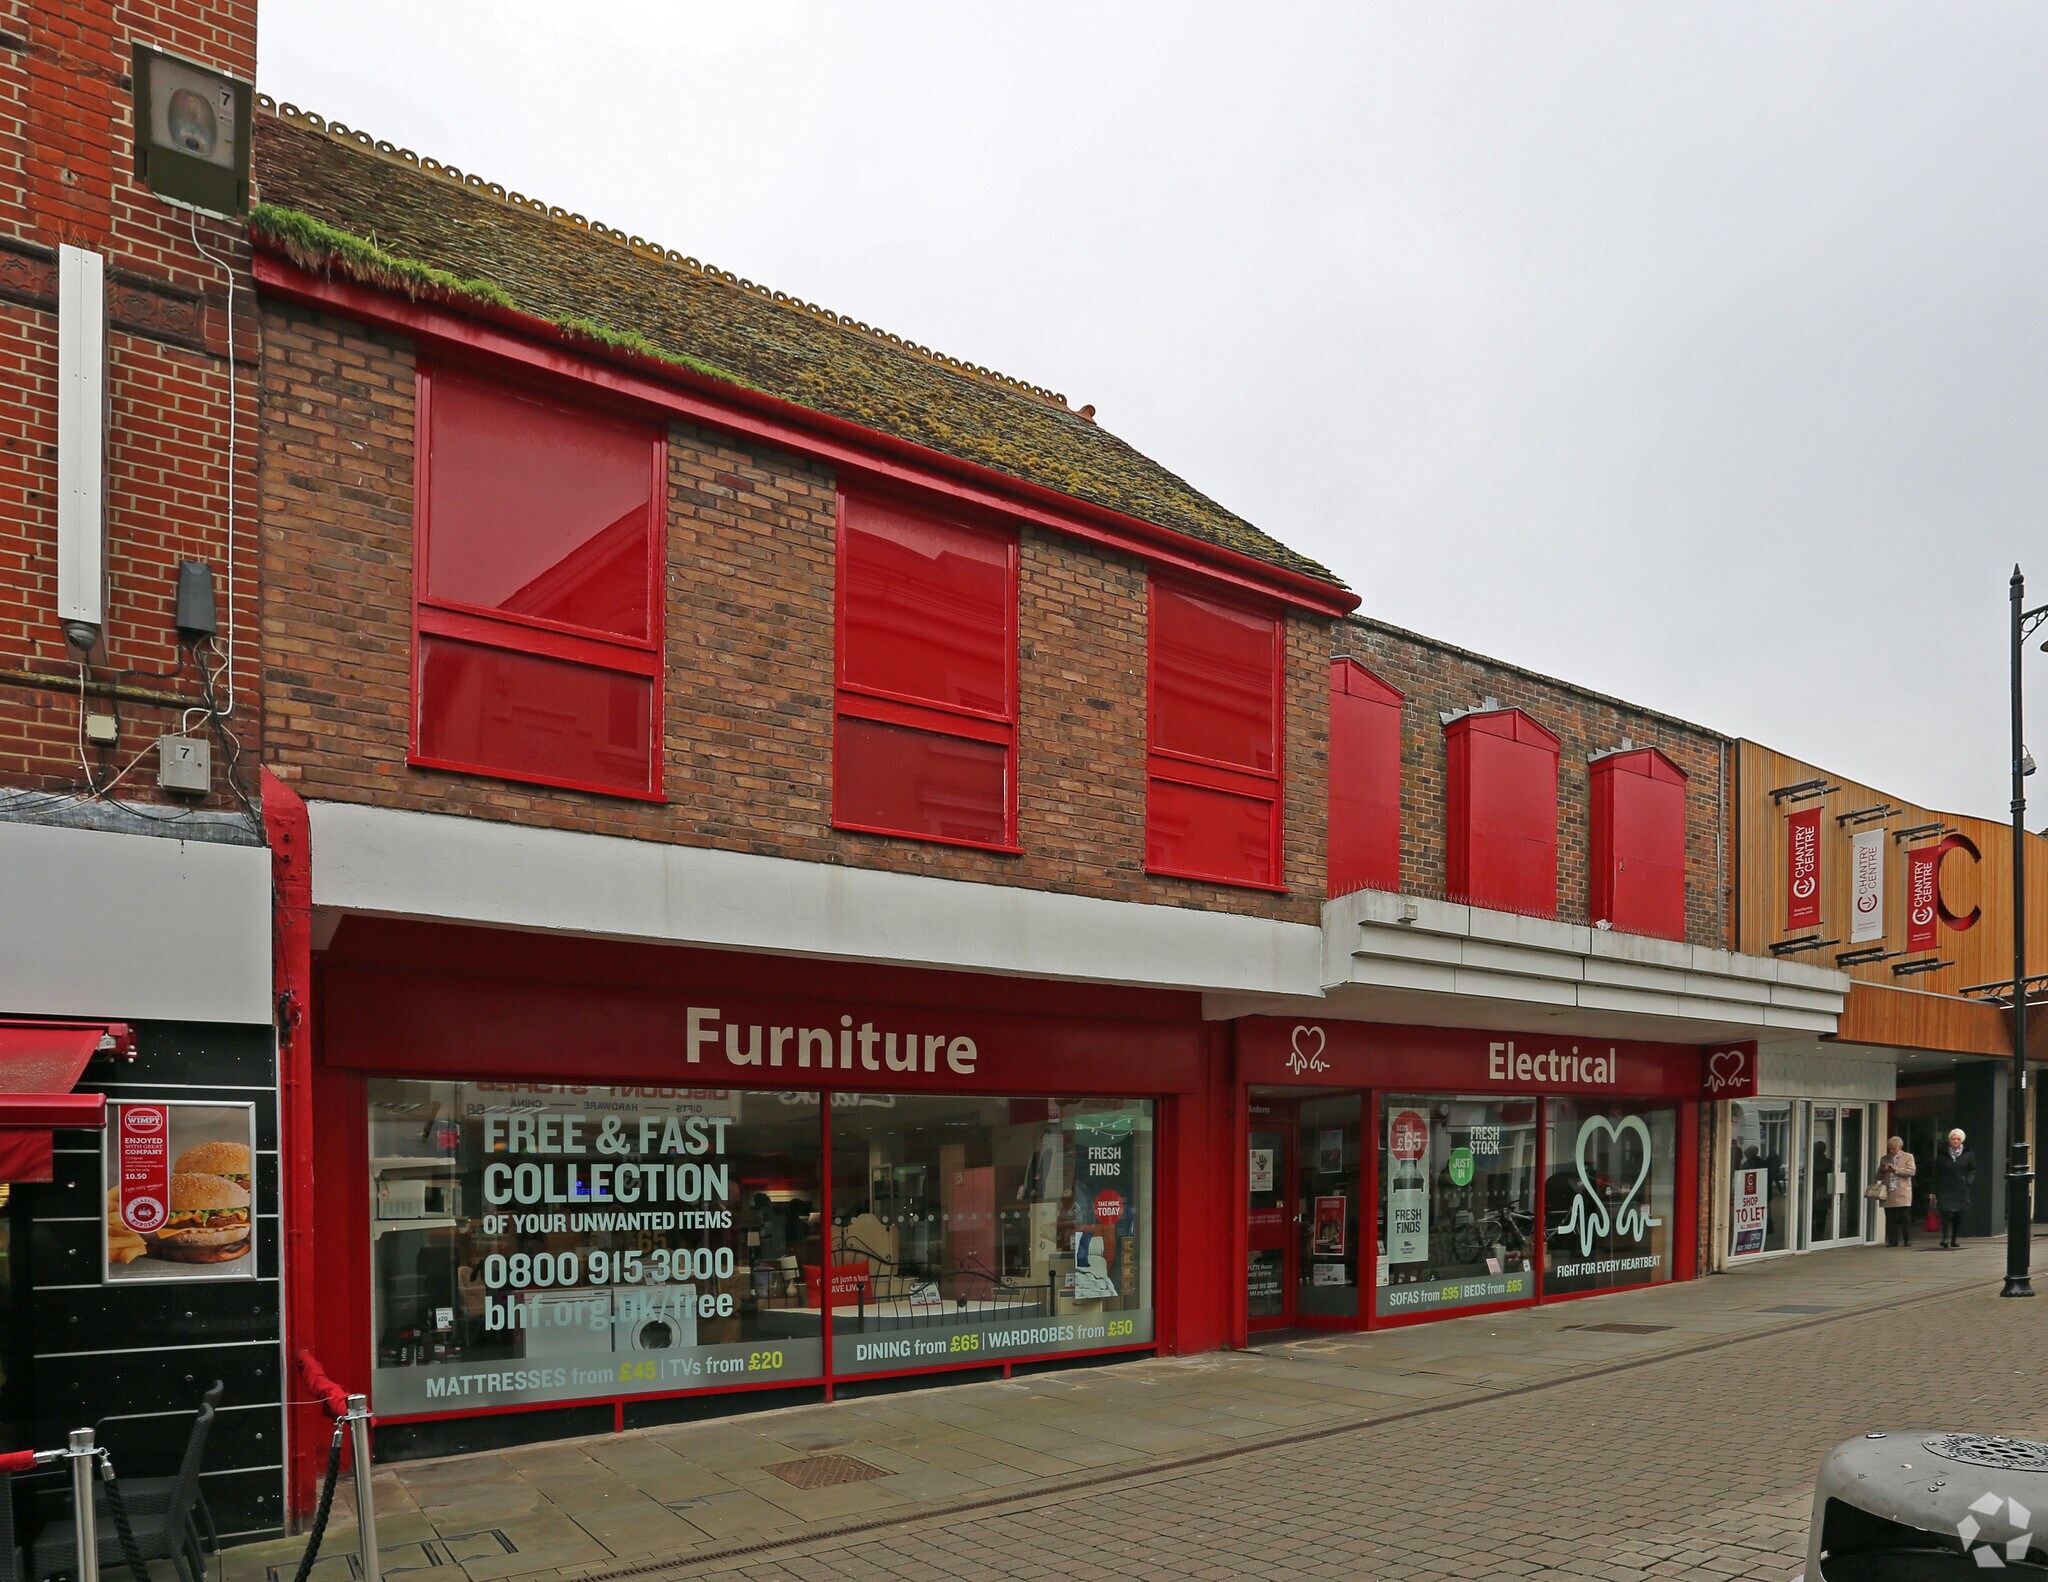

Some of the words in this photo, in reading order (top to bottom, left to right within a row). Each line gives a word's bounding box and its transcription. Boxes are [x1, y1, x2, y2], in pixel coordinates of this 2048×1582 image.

[221, 92, 232, 105] 7
[180, 748, 190, 758] 7
[1795, 826, 1804, 878] CHANTRY
[1805, 826, 1815, 872] CENTRE
[1859, 846, 1868, 894] CHANTRY
[1868, 846, 1877, 889] CENTRE
[1914, 862, 1923, 908] CHANTRY
[1923, 862, 1932, 902] CENTRE
[687, 1006, 978, 1074] Furniture
[1489, 1042, 1616, 1084] Electrical
[484, 1114, 586, 1154] FREE
[595, 1114, 632, 1155] &
[639, 1116, 733, 1156] FAST
[1396, 1132, 1422, 1152] £65
[1470, 1126, 1500, 1141] FRESH
[1088, 1146, 1122, 1160] FRESH
[1470, 1140, 1500, 1156] STOCK
[1089, 1162, 1120, 1176] FINDS
[1453, 1158, 1470, 1170] JUST
[1458, 1169, 1465, 1179] IN
[484, 1163, 728, 1205] COLLECTION
[132, 1197, 157, 1205] CLASSIC
[1098, 1207, 1120, 1216] TODAY
[1743, 1197, 1758, 1207] SHOP
[132, 1218, 159, 1227] BURGERS
[483, 1214, 508, 1235] OF
[512, 1212, 566, 1234] YOUR
[570, 1212, 675, 1233] UNWANTED
[678, 1210, 732, 1230] ITEMS
[1396, 1208, 1422, 1222] FRESH
[1736, 1208, 1748, 1223] TO
[1750, 1206, 1765, 1221] LET
[1396, 1222, 1421, 1234] FINDS
[484, 1252, 579, 1289] 0800
[588, 1250, 642, 1284] 915
[651, 1247, 734, 1281] 3000
[1556, 1264, 1580, 1278] FIGHT
[1581, 1262, 1596, 1276] FOR
[1596, 1260, 1620, 1274] EVERY
[1620, 1255, 1661, 1272] HEARTBEAT
[1390, 1290, 1419, 1306] SOFAS
[1420, 1288, 1440, 1303] from
[1442, 1286, 1459, 1300] £95
[1464, 1284, 1486, 1298] BEDS
[1487, 1282, 1505, 1296] from
[1506, 1280, 1522, 1293] £65
[484, 1284, 734, 1332] bhf.org.uk/free
[856, 1344, 911, 1362] DINING
[914, 1339, 946, 1355] from
[950, 1334, 980, 1352] £65
[988, 1325, 1074, 1348] WARDROBES
[1077, 1324, 1105, 1340] from
[1107, 1320, 1134, 1337] £50
[426, 1368, 566, 1398] MATTRESSES
[571, 1365, 614, 1386] from
[618, 1362, 656, 1382] £45
[669, 1359, 702, 1378] TVs
[706, 1355, 744, 1374] from
[748, 1351, 784, 1371] £20
